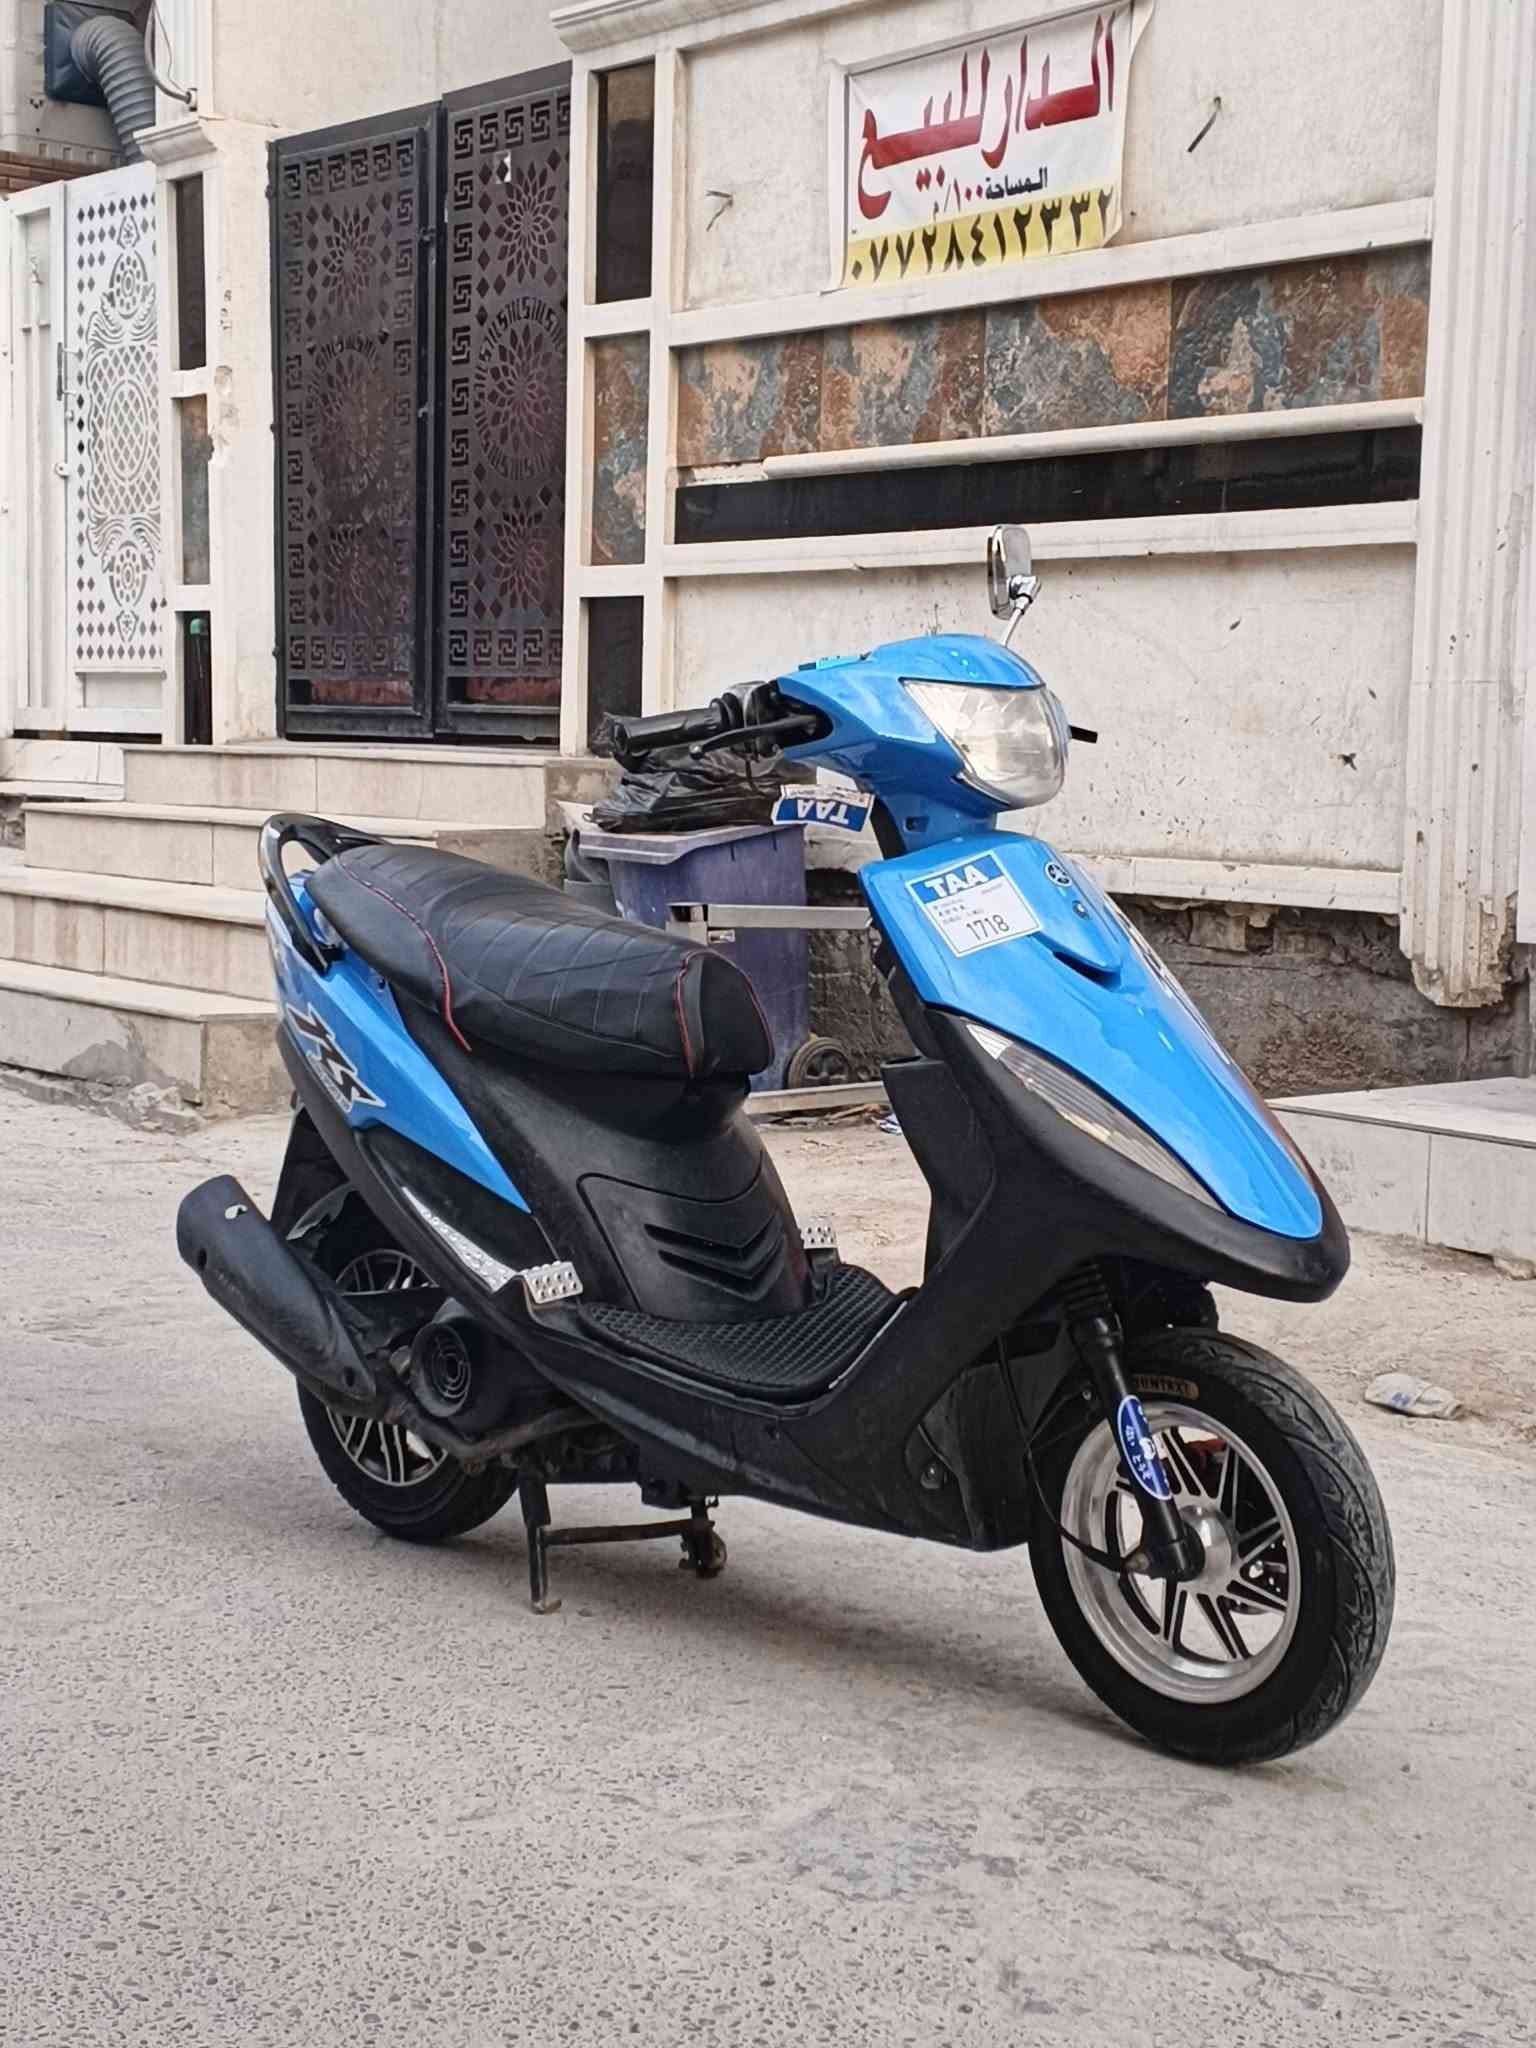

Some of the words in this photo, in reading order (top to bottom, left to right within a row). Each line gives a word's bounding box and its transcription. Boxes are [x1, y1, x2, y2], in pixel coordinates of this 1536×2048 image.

[980, 11, 1115, 169] الدار
[857, 46, 990, 220] للبيع
[985, 166, 1048, 200] المساحة
[851, 186, 1114, 282] ٠٧٧٢٨٤١٢٣٣٢
[797, 799, 849, 824] TAA
[924, 865, 988, 898] TAA
[966, 914, 1010, 941] 1718
